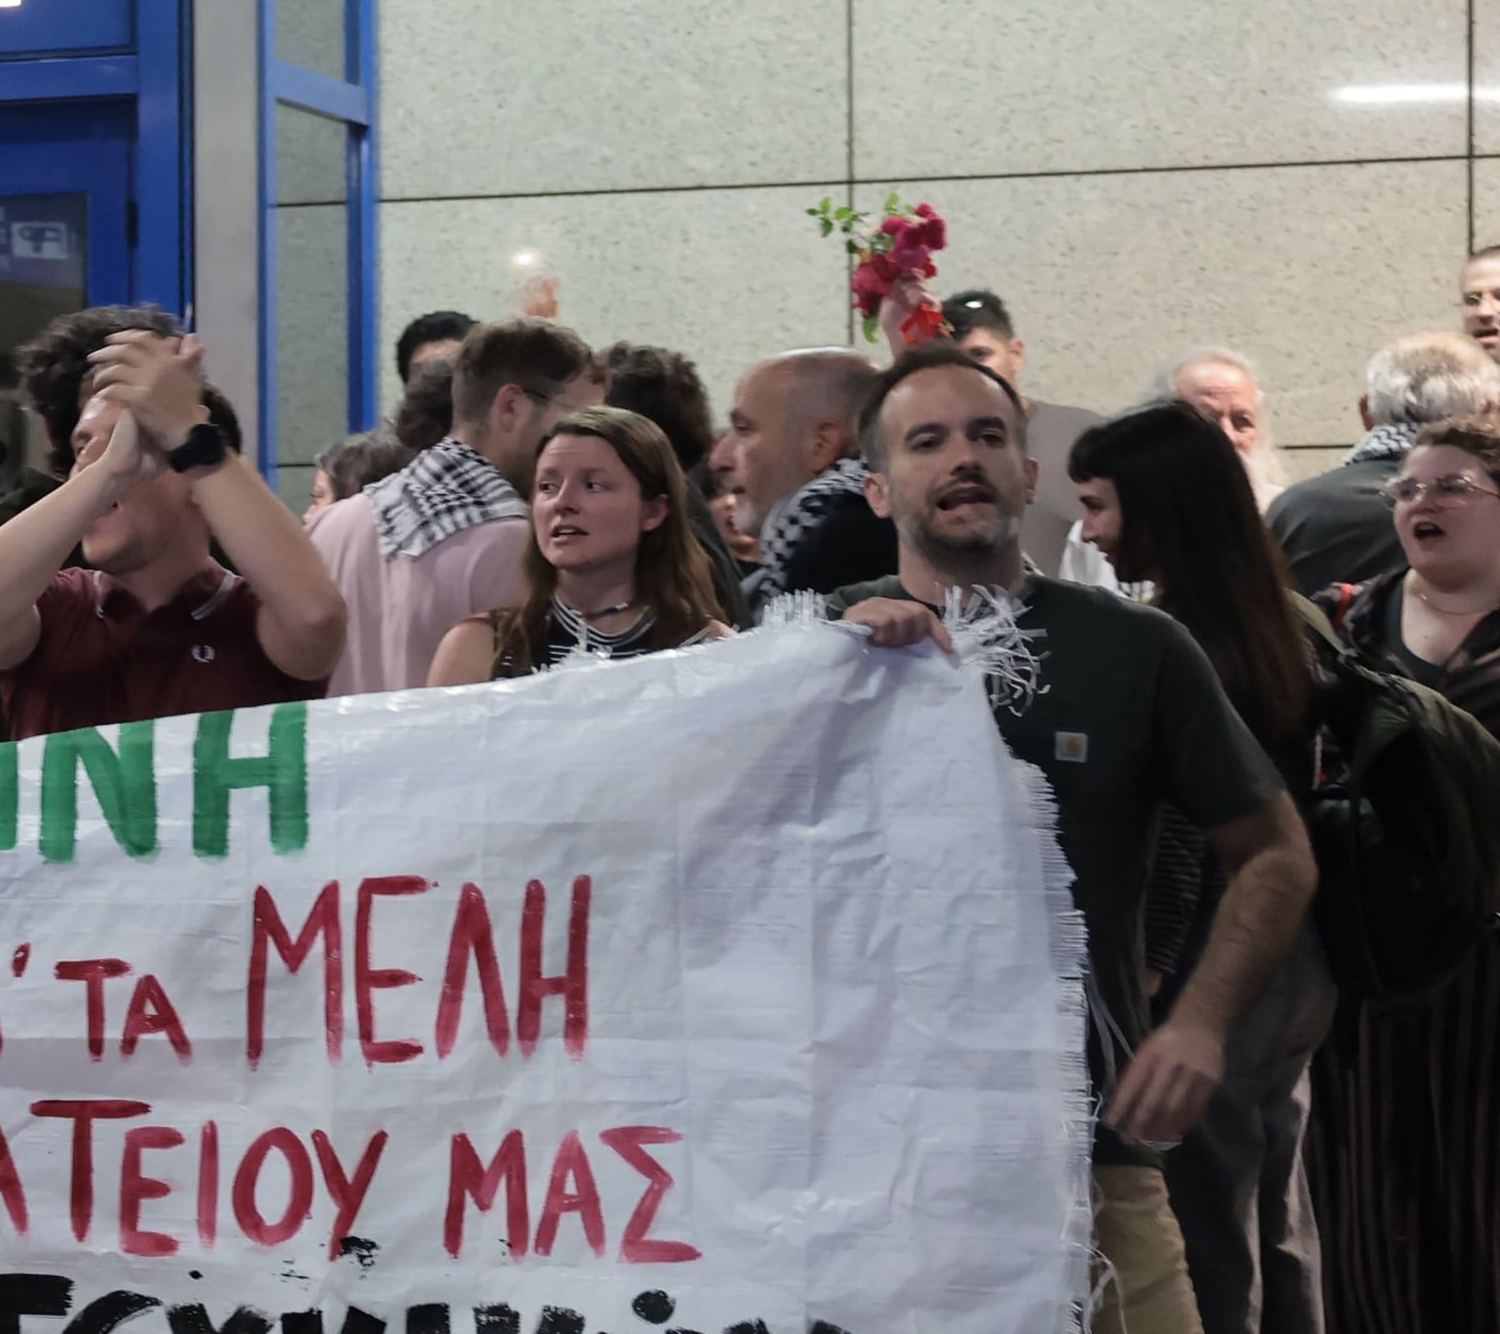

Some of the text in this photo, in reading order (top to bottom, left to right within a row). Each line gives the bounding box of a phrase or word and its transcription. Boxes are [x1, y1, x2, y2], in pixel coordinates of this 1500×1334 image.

[54, 958, 192, 1059] ΤΑ
[246, 874, 592, 1064] ΜΕΛΗ
[443, 1123, 703, 1264] ΜΑΣ
